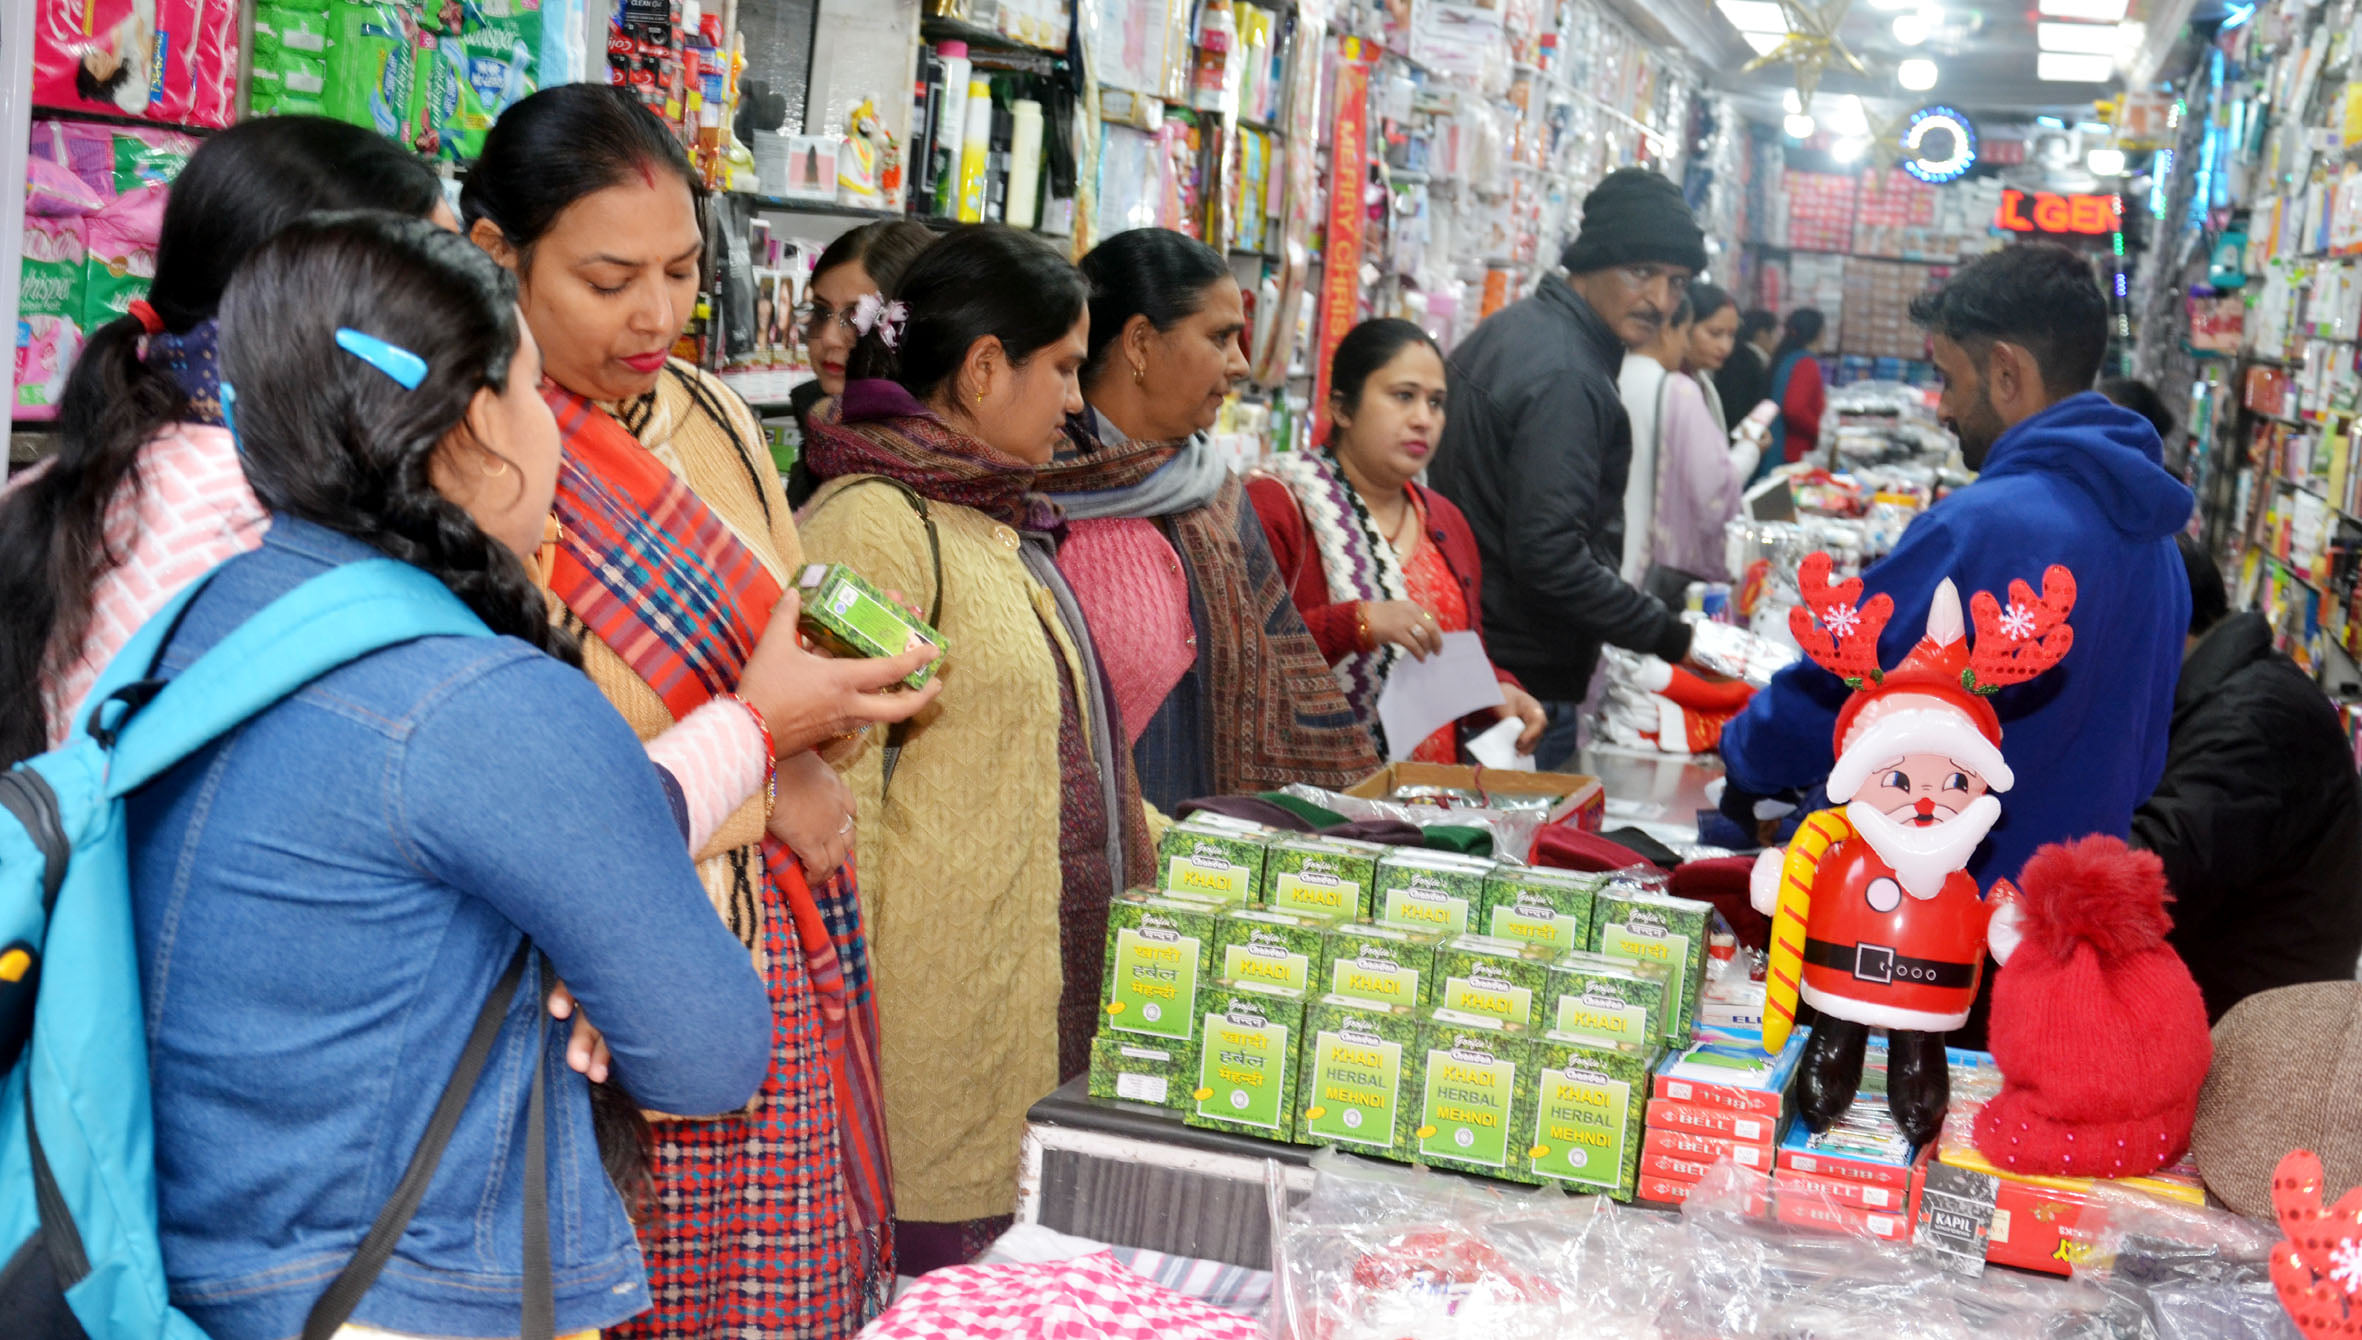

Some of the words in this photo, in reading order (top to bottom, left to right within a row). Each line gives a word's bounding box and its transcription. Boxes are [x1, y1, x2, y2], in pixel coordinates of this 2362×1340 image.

[1337, 121, 1359, 230] MERRY
[1184, 872, 1232, 891] KHADI
[1292, 888, 1342, 907] KHADI
[1401, 904, 1450, 924] KHADI
[1508, 922, 1559, 941] खादी
[1133, 945, 1182, 963] खादी
[1620, 940, 1670, 960] खादी
[1240, 960, 1290, 981] KHADI
[1350, 975, 1400, 995] KHADI
[1461, 993, 1513, 1014] KHADI
[1574, 1012, 1627, 1033] KHADI
[1220, 1030, 1269, 1049] खादी
[1331, 1047, 1384, 1069] KHADI
[1327, 1068, 1387, 1089] HERBAL
[1443, 1065, 1496, 1087] KHADI
[1325, 1086, 1386, 1109] MEHNDI
[1438, 1086, 1499, 1108] HERBAL
[1556, 1084, 1611, 1107] KHADI
[1699, 1090, 1746, 1110] BELL
[1437, 1106, 1497, 1128] MEHNDI
[1551, 1105, 1614, 1128] HERBAL
[1679, 1114, 1729, 1131] BELL
[1550, 1125, 1612, 1148] MEHNDI
[1824, 1164, 1873, 1179] BELL
[1806, 1180, 1857, 1198] BELL
[1936, 1212, 1972, 1233] KAPIL
